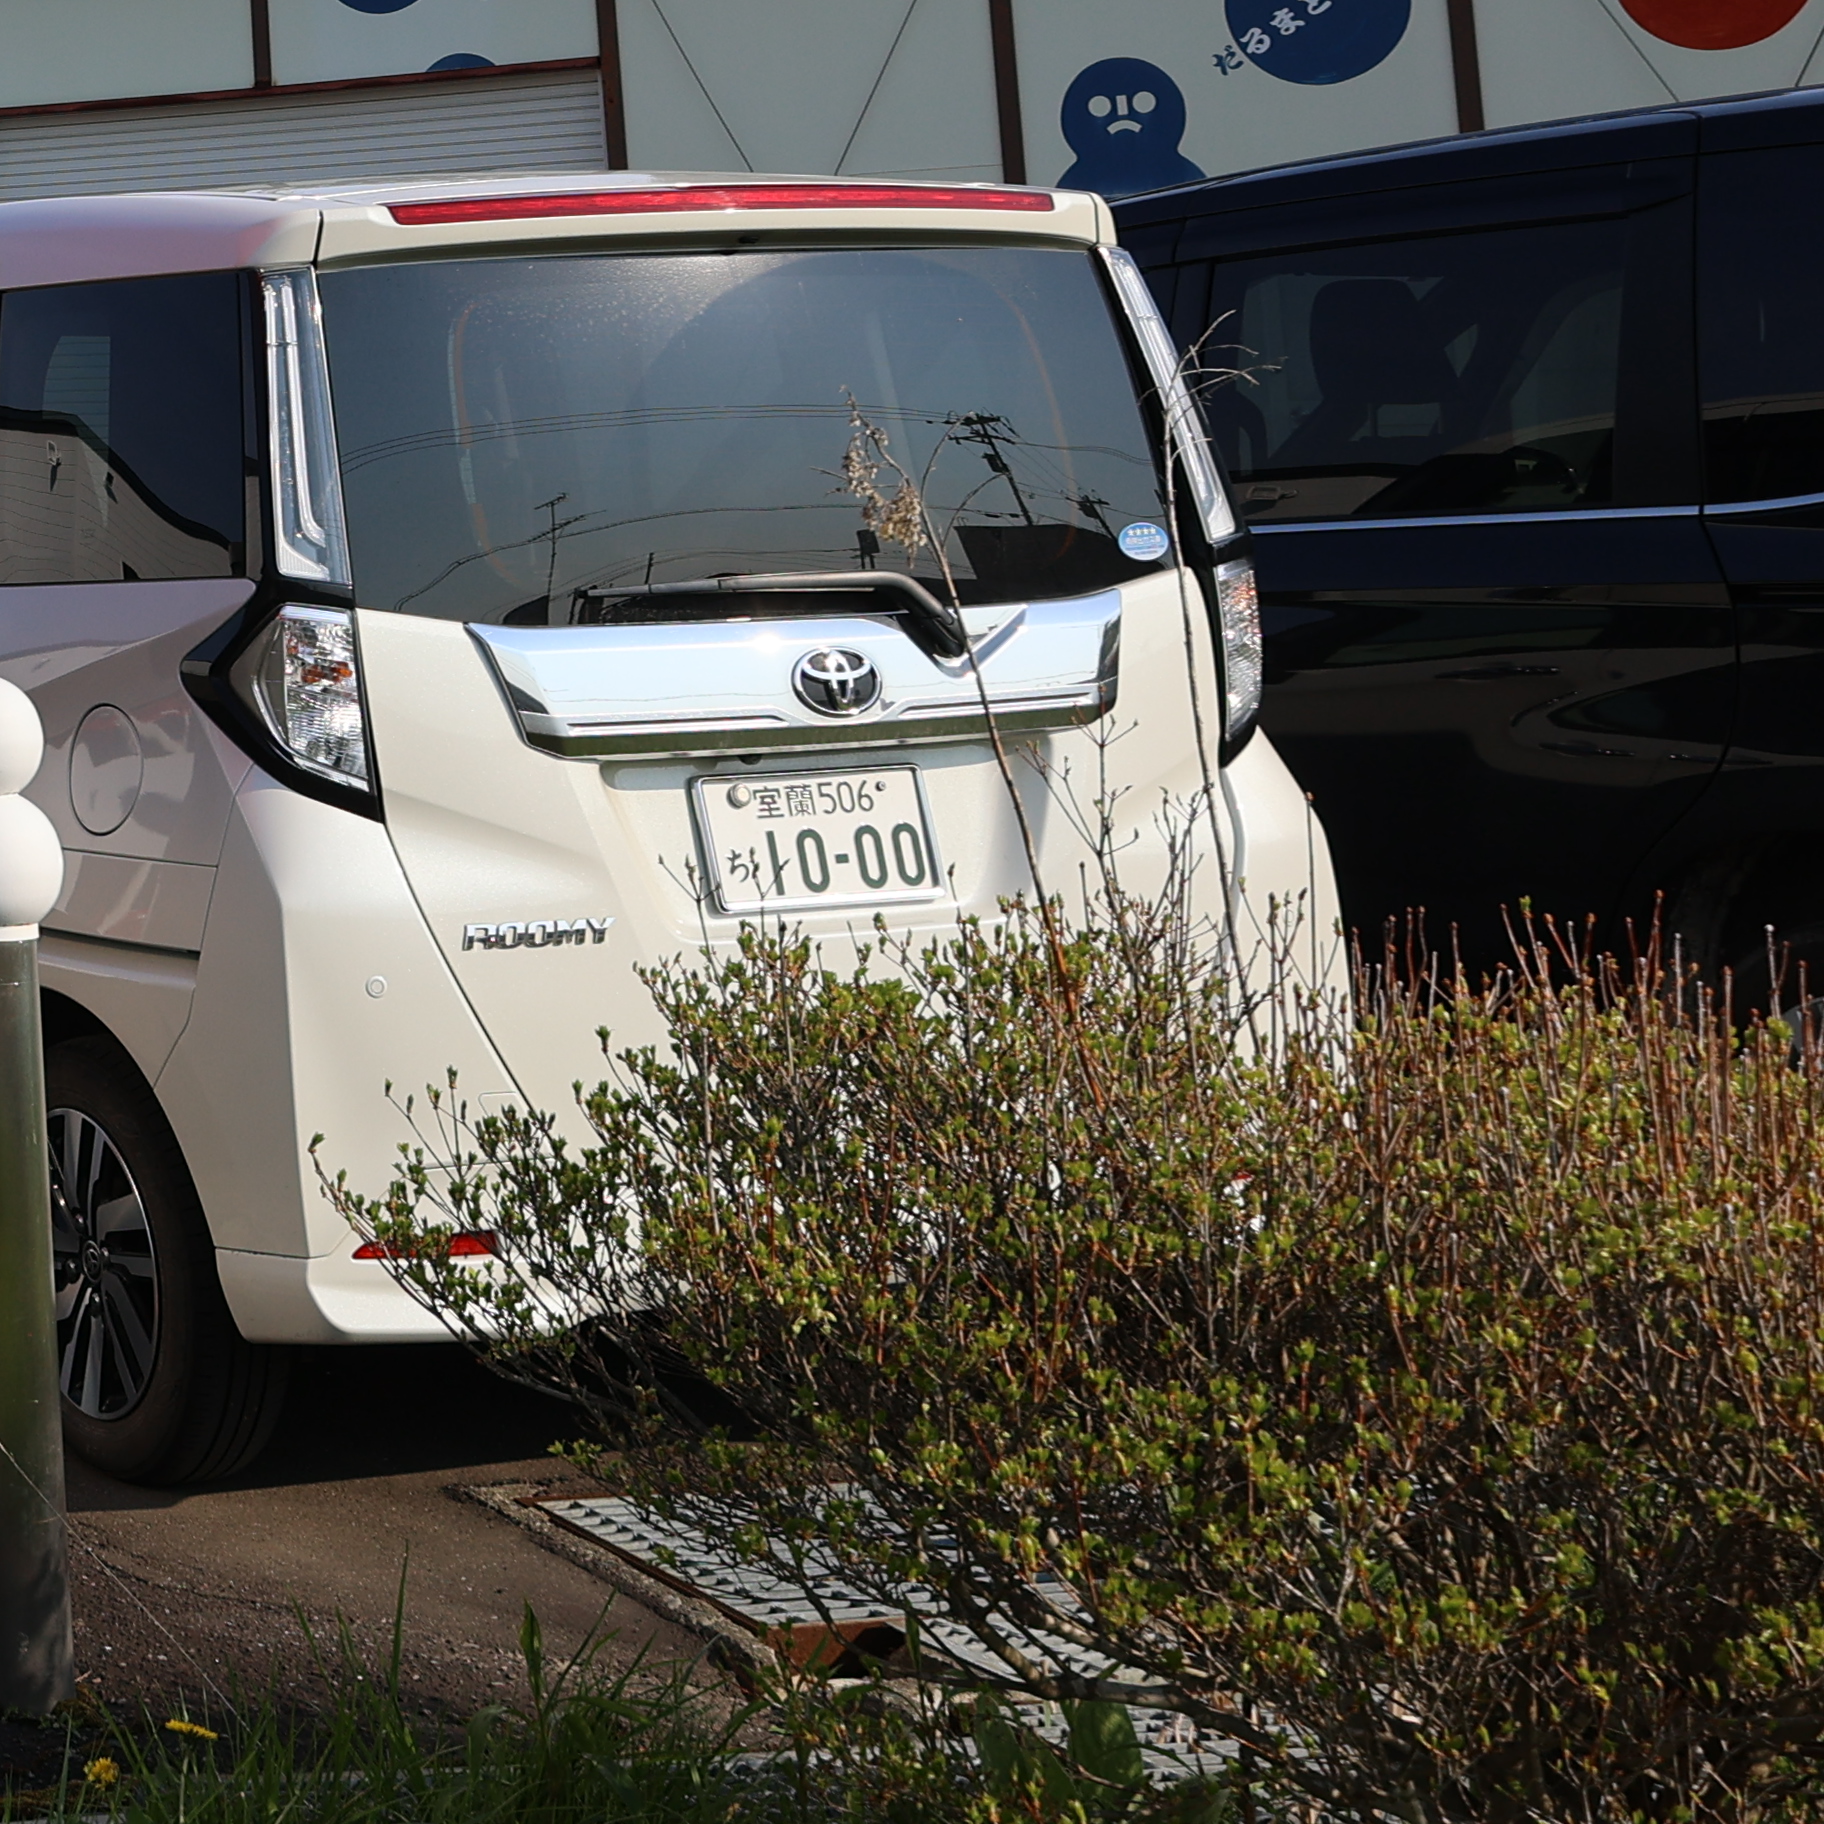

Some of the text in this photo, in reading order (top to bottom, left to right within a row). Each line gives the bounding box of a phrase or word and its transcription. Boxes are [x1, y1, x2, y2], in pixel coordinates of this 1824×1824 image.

[727, 821, 926, 896] ち 10-00
[462, 916, 616, 951] ROOMY
